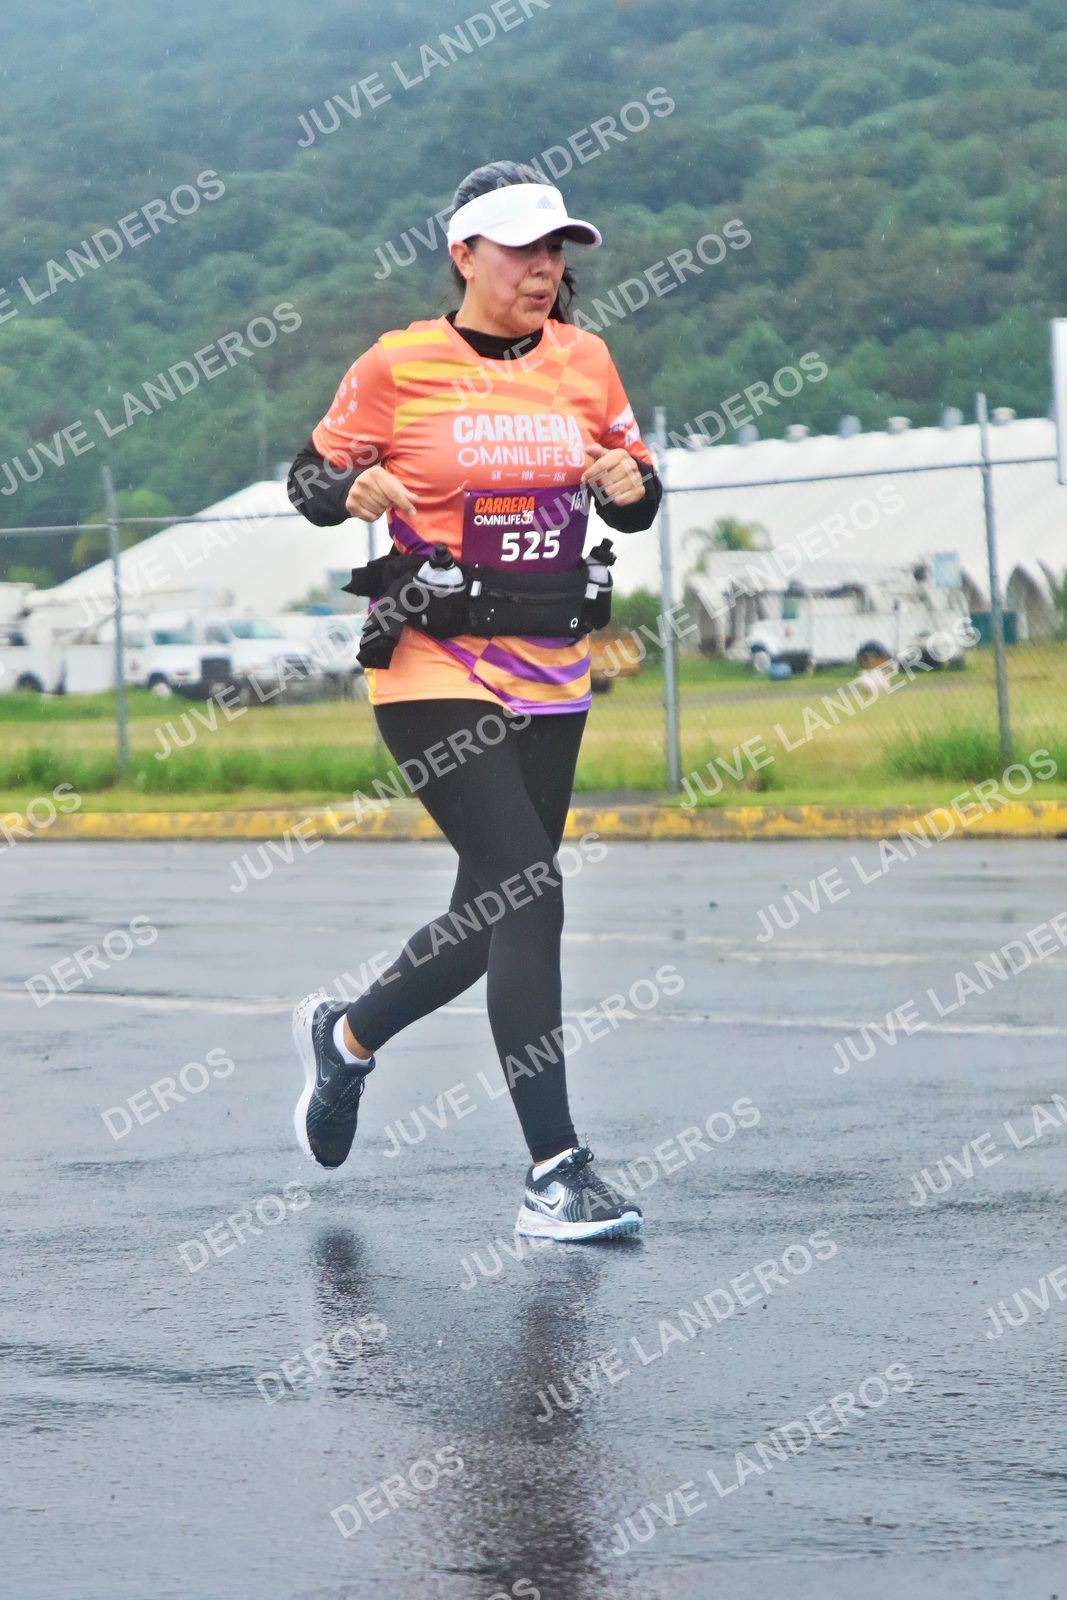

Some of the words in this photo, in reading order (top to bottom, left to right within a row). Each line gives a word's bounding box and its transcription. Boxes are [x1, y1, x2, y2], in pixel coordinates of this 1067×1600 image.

[453, 414, 582, 443] CARRERA
[457, 446, 564, 467] OMNILIFE
[474, 496, 535, 514] CARRERA
[501, 530, 560, 562] 525
